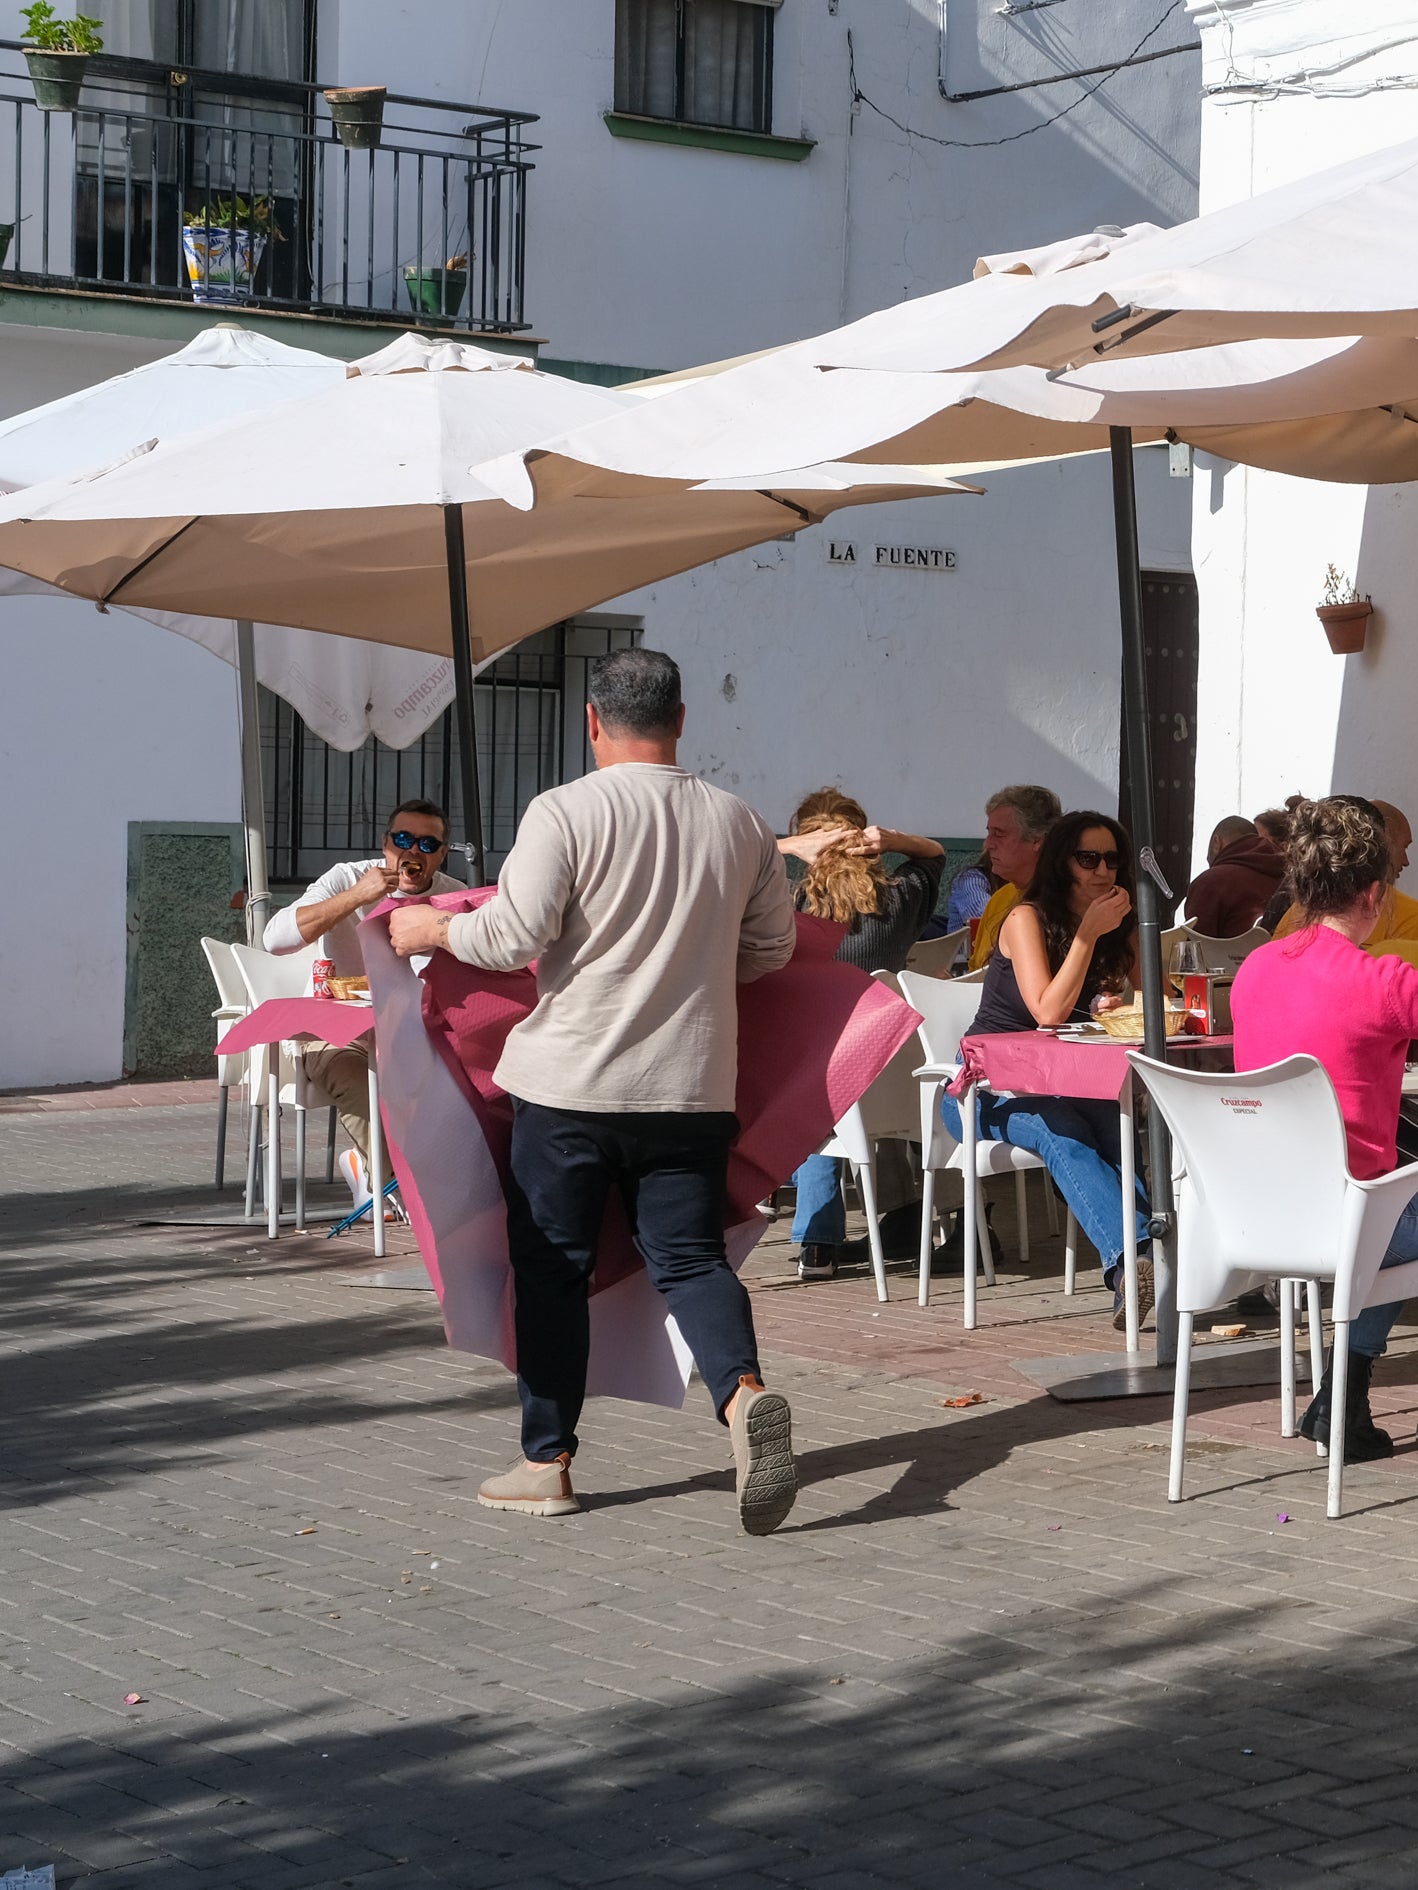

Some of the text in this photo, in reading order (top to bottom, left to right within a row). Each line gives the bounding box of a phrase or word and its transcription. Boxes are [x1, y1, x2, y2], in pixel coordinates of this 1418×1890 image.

[829, 543, 956, 568] LA FUENTE
[1221, 1098, 1262, 1107] Cruzcampo
